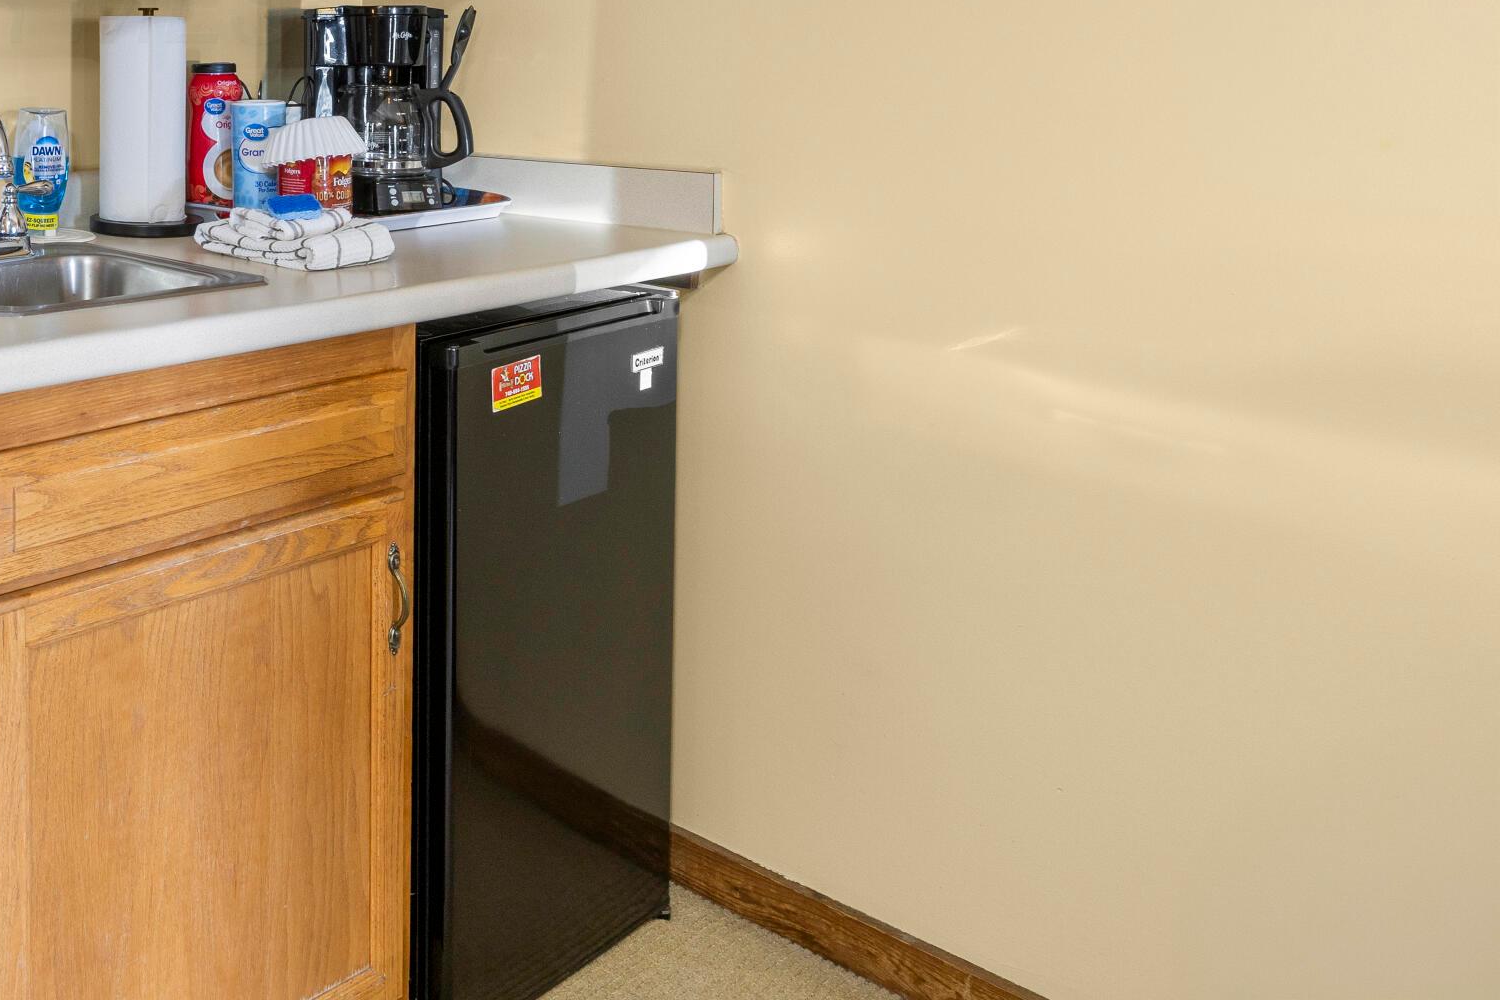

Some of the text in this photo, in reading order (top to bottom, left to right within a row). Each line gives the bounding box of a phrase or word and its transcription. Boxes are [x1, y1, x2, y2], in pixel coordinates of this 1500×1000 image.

[32, 146, 61, 156] DAWN
[315, 191, 335, 201] 100%
[514, 361, 532, 374] PIZZA
[634, 355, 660, 368] Criterion
[514, 371, 534, 386] DOCK
